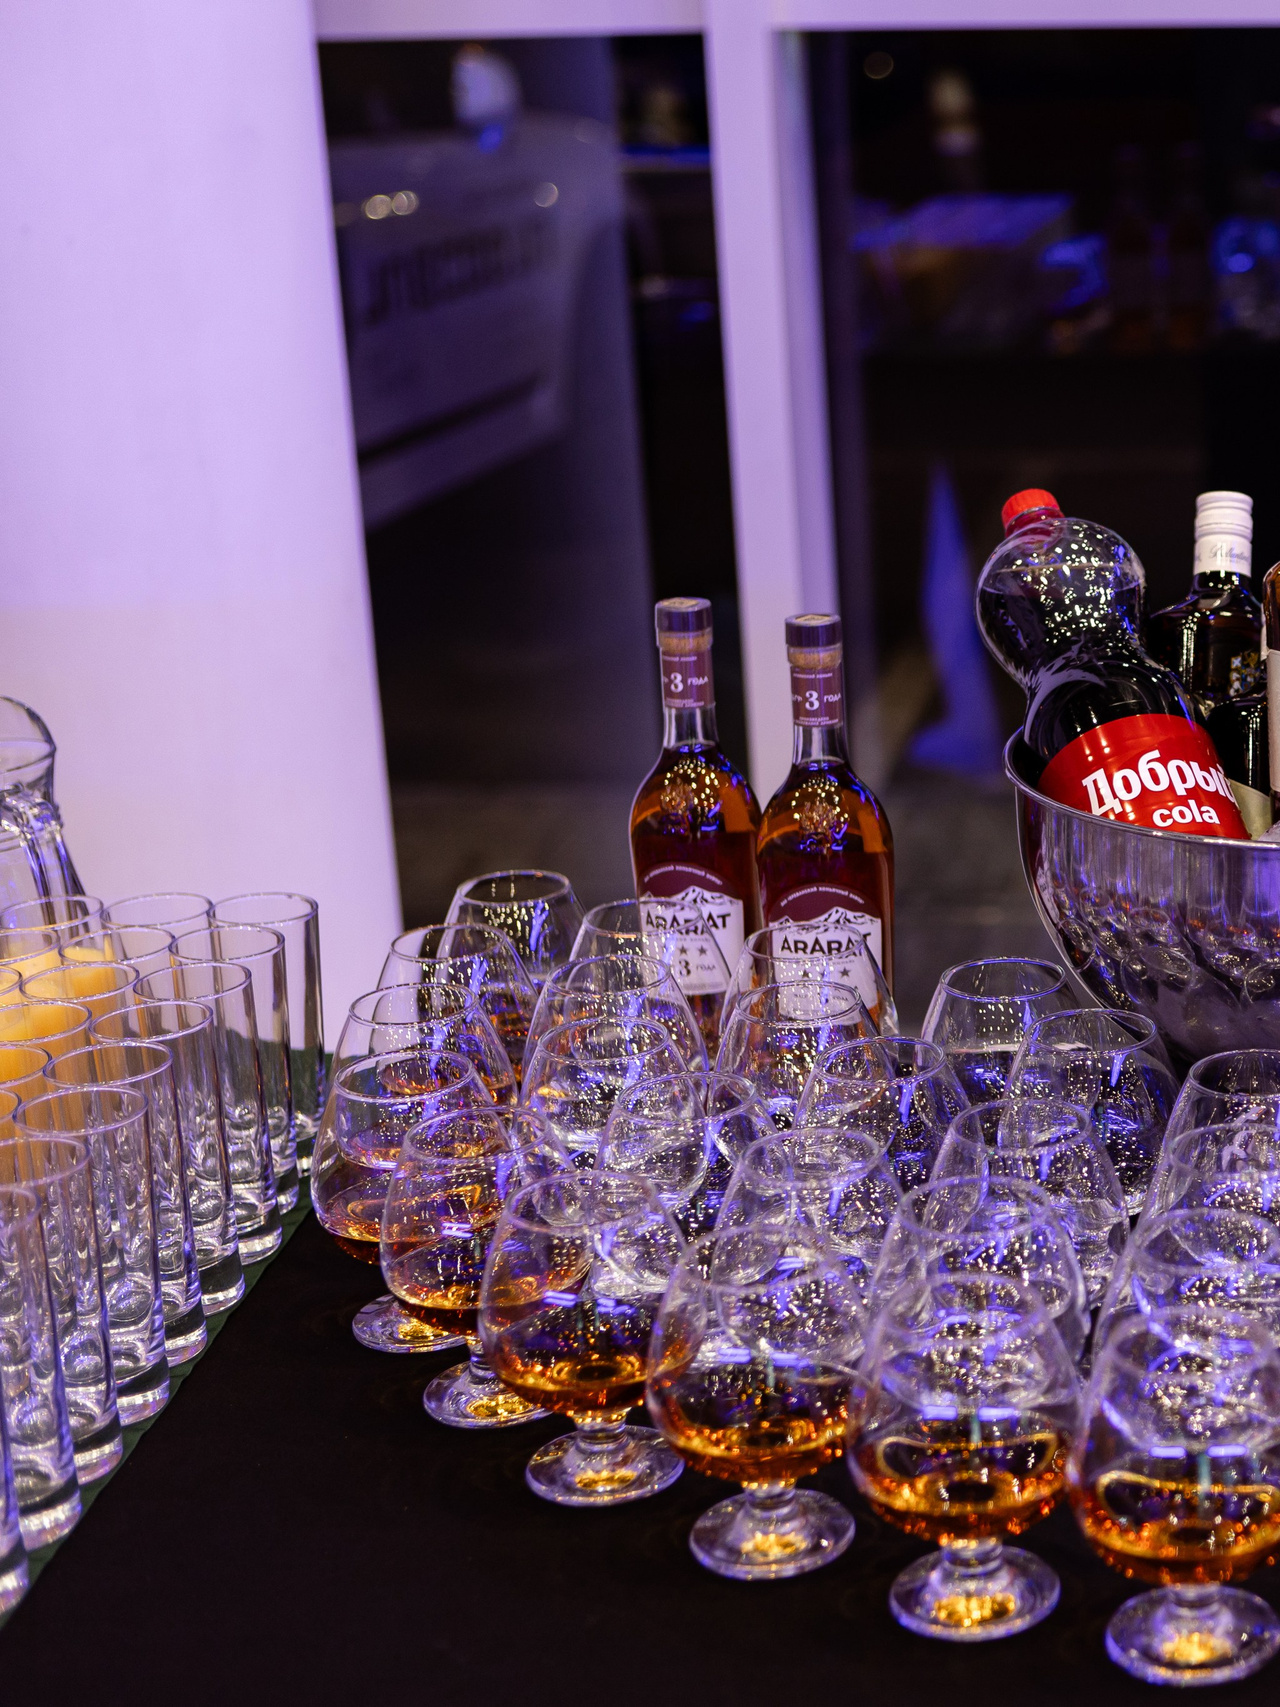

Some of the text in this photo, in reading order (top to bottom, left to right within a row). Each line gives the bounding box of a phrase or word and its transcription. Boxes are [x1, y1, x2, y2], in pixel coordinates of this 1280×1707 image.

[670, 672, 684, 693] 3
[805, 690, 820, 711] 3
[1152, 799, 1221, 828] cola
[645, 909, 731, 933] ARARAT
